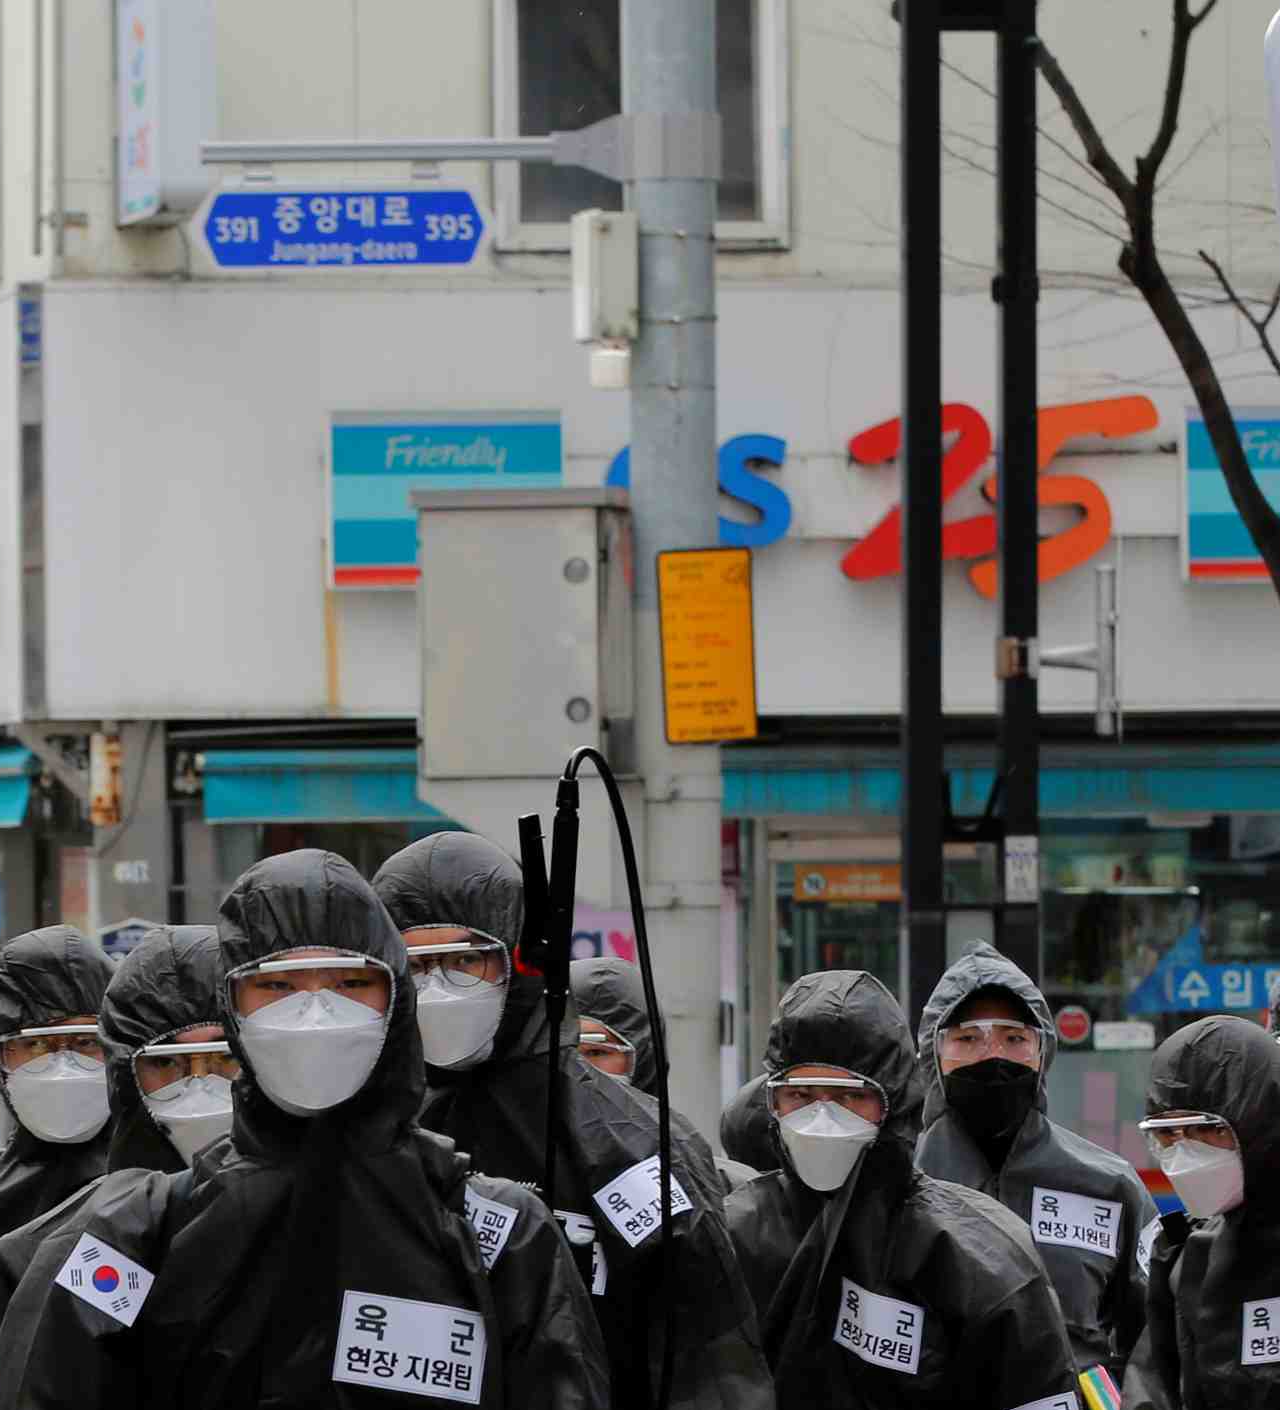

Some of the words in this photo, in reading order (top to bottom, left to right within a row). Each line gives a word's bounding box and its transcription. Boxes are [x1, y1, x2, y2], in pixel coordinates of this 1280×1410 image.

[214, 217, 259, 242] 391
[273, 197, 414, 232] 중앙대로
[425, 215, 475, 241] 395
[269, 239, 418, 263] Jungang-daero
[383, 435, 508, 474] Friendly
[1039, 1195, 1059, 1217] 육
[1093, 1206, 1112, 1228] 군
[1037, 1221, 1067, 1239] 현장
[1070, 1226, 1112, 1249] 지원팀
[353, 1303, 388, 1342] 육
[449, 1318, 475, 1357] 군
[895, 1309, 916, 1338] 군
[1252, 1306, 1271, 1332] 육
[840, 1318, 863, 1347] 현장
[863, 1333, 913, 1366] 지원팀
[1250, 1336, 1280, 1357] 현장
[344, 1346, 399, 1378] 현장
[403, 1355, 473, 1392] 지원팀
